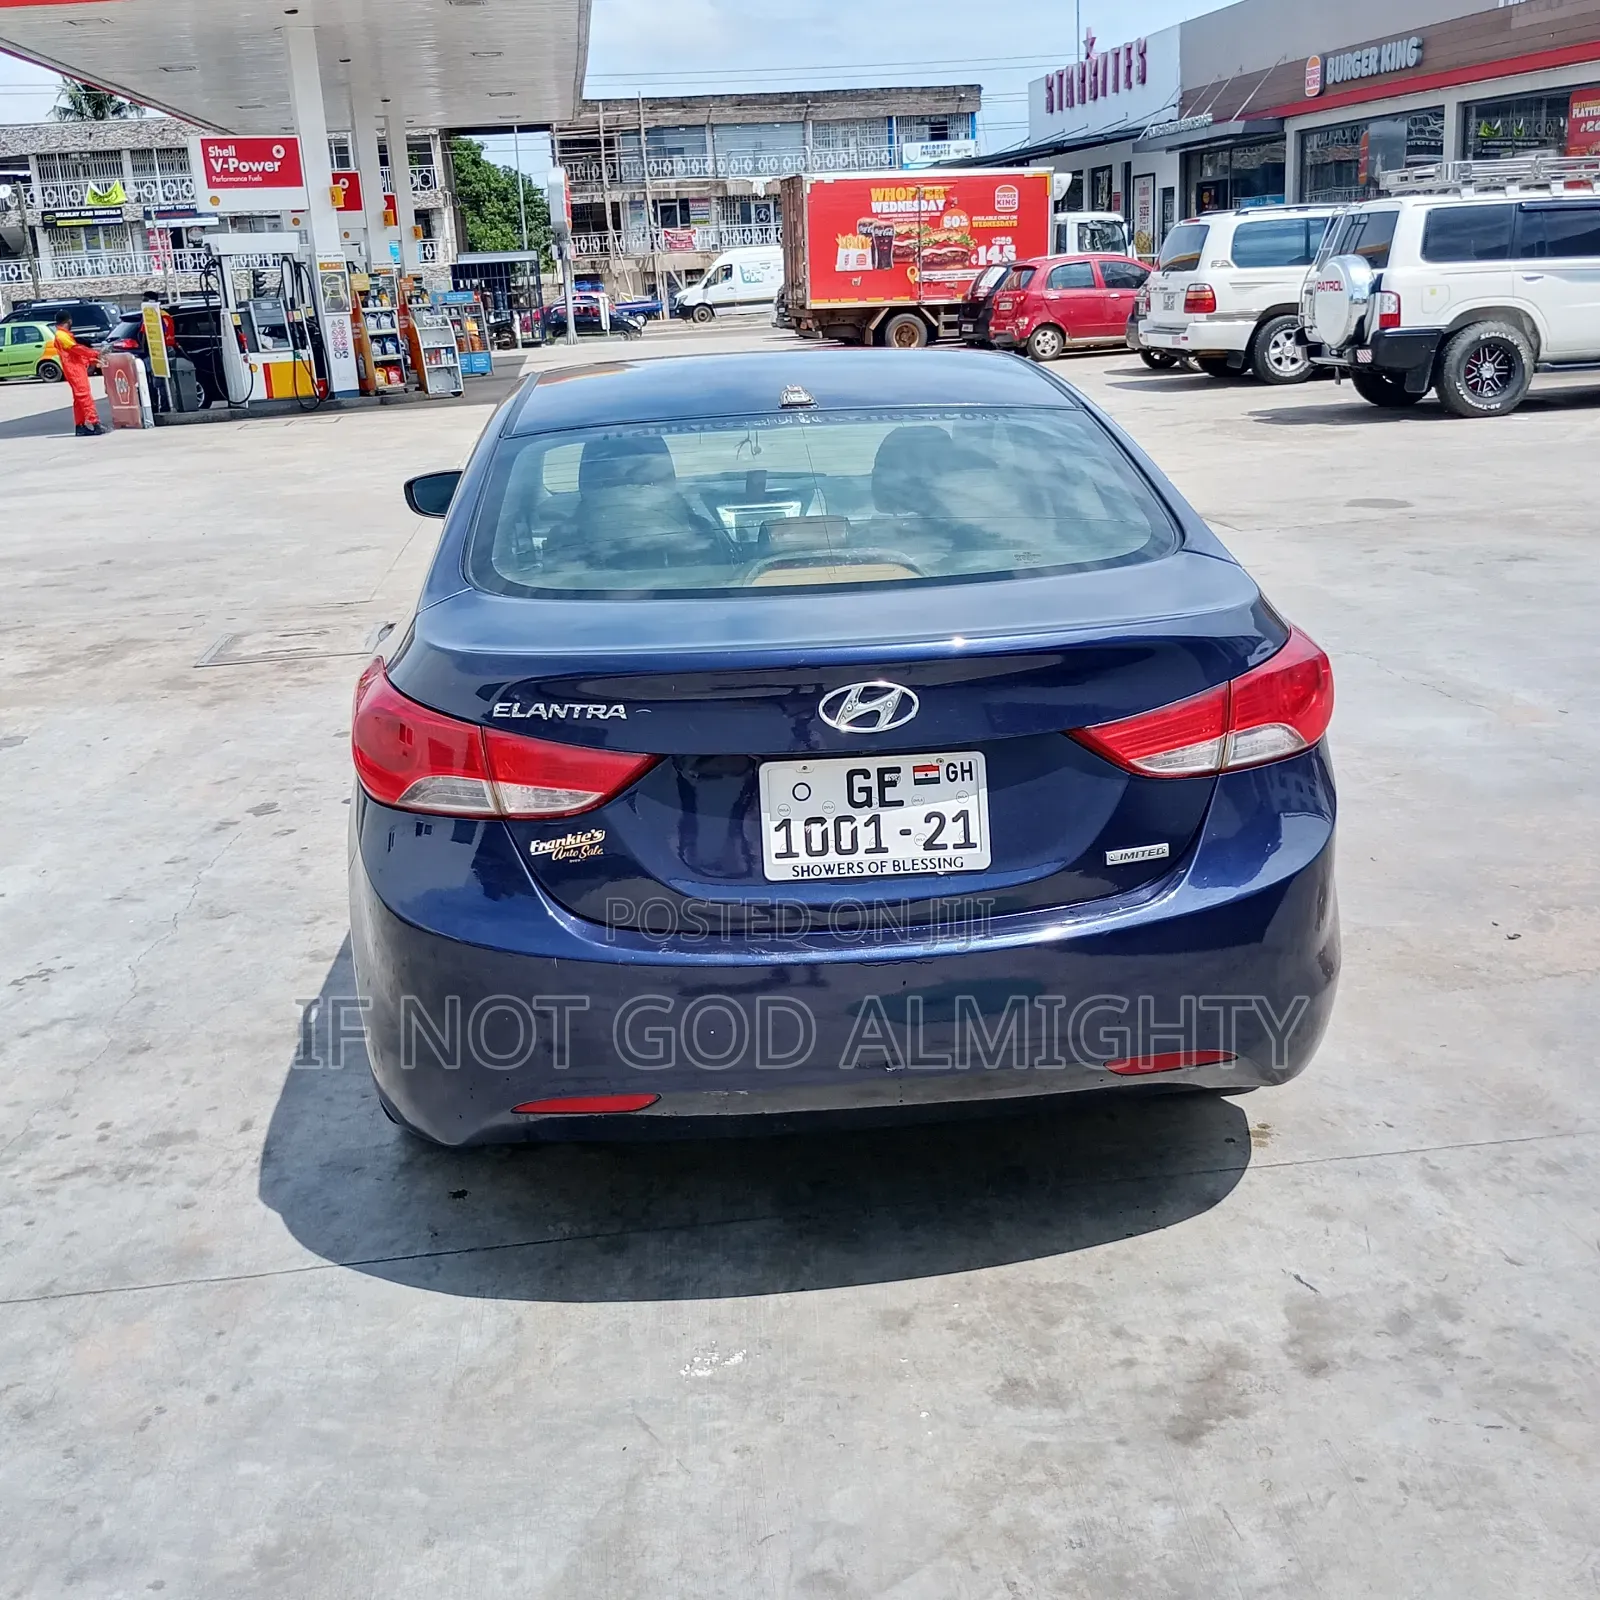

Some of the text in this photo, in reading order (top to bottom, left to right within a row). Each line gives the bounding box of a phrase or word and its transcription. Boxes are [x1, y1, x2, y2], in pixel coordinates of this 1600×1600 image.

[1326, 37, 1420, 85] BURGER KING
[1045, 37, 1147, 115] STARBITES
[208, 145, 236, 157] Shell
[209, 158, 282, 173] V-Power
[212, 174, 263, 183] Performance Fuels
[870, 187, 946, 201] WHOPER
[871, 199, 947, 213] WEDNESDAY
[972, 220, 1018, 228] WEDNESDAYS
[1317, 280, 1344, 293] PATROL
[492, 702, 628, 720] ELANTRA
[846, 761, 974, 809] GE GH
[530, 829, 606, 855] Frankie's
[552, 846, 579, 861] Auto
[792, 856, 964, 878] SHOWERS OF BLESSING
